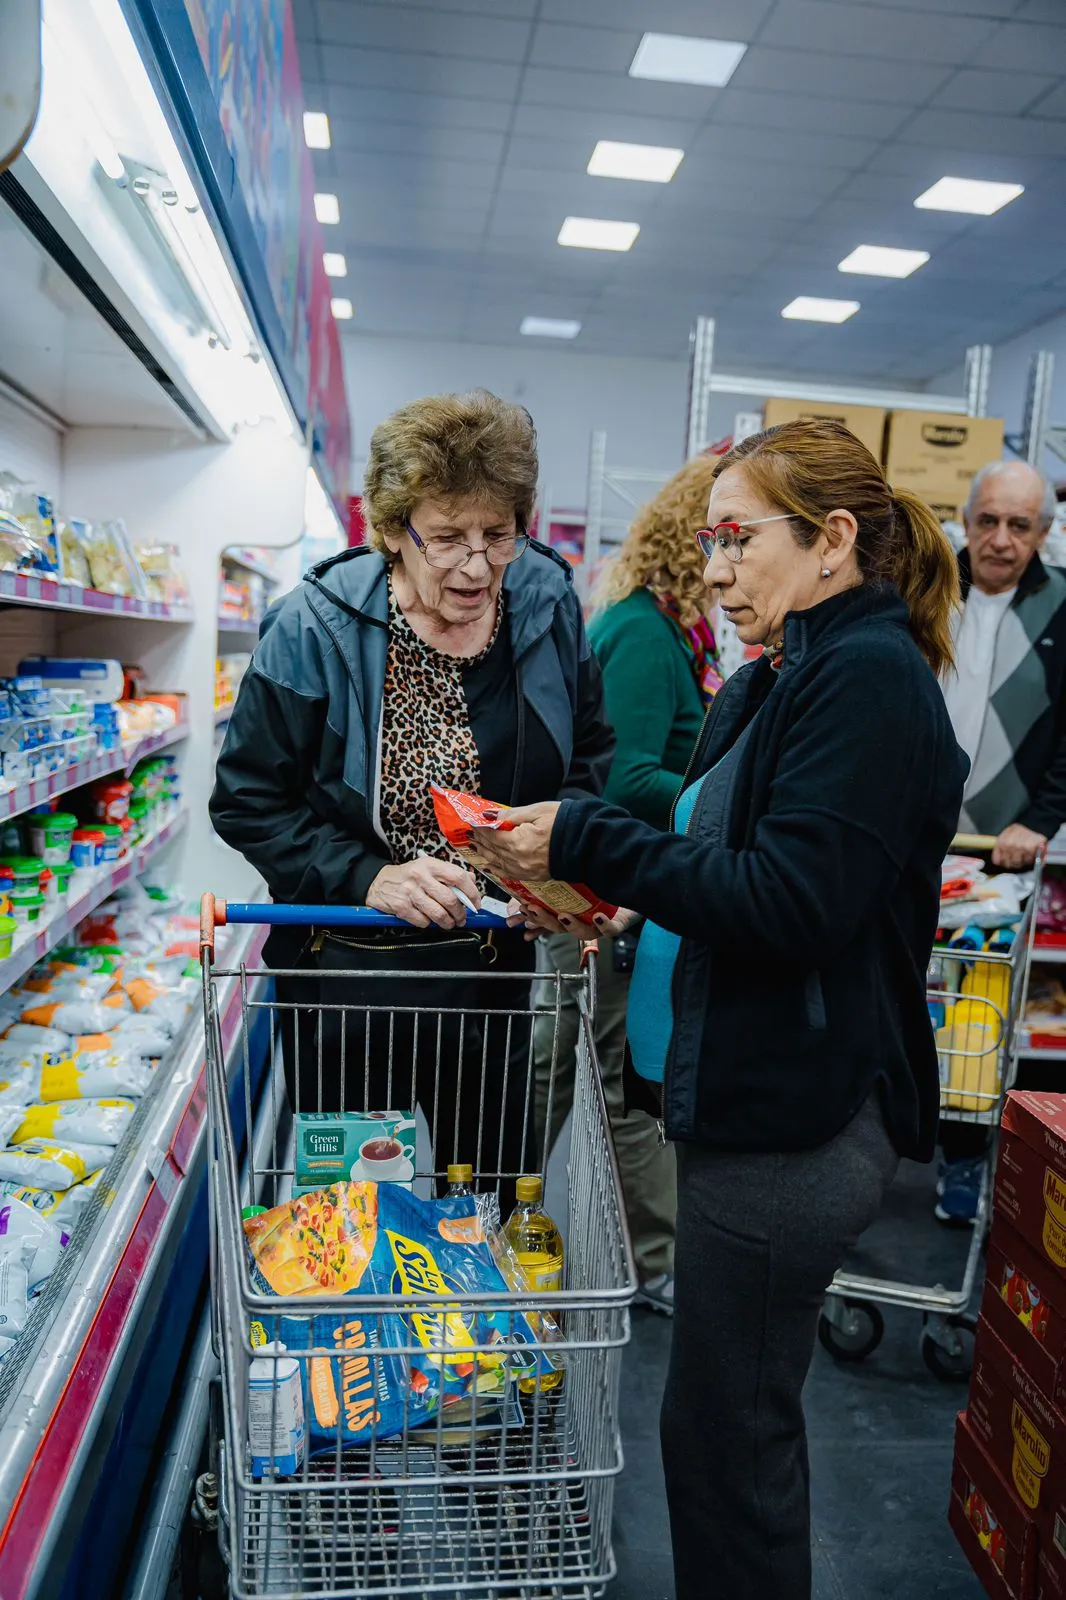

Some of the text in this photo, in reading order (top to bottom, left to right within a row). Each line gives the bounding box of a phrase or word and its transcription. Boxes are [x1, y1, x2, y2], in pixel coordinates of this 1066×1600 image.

[310, 1134, 339, 1145] Green
[314, 1143, 338, 1153] Hills
[425, 1271, 439, 1288] La
[378, 1373, 390, 1402] TARTAS
[1014, 1408, 1047, 1467] Marolio
